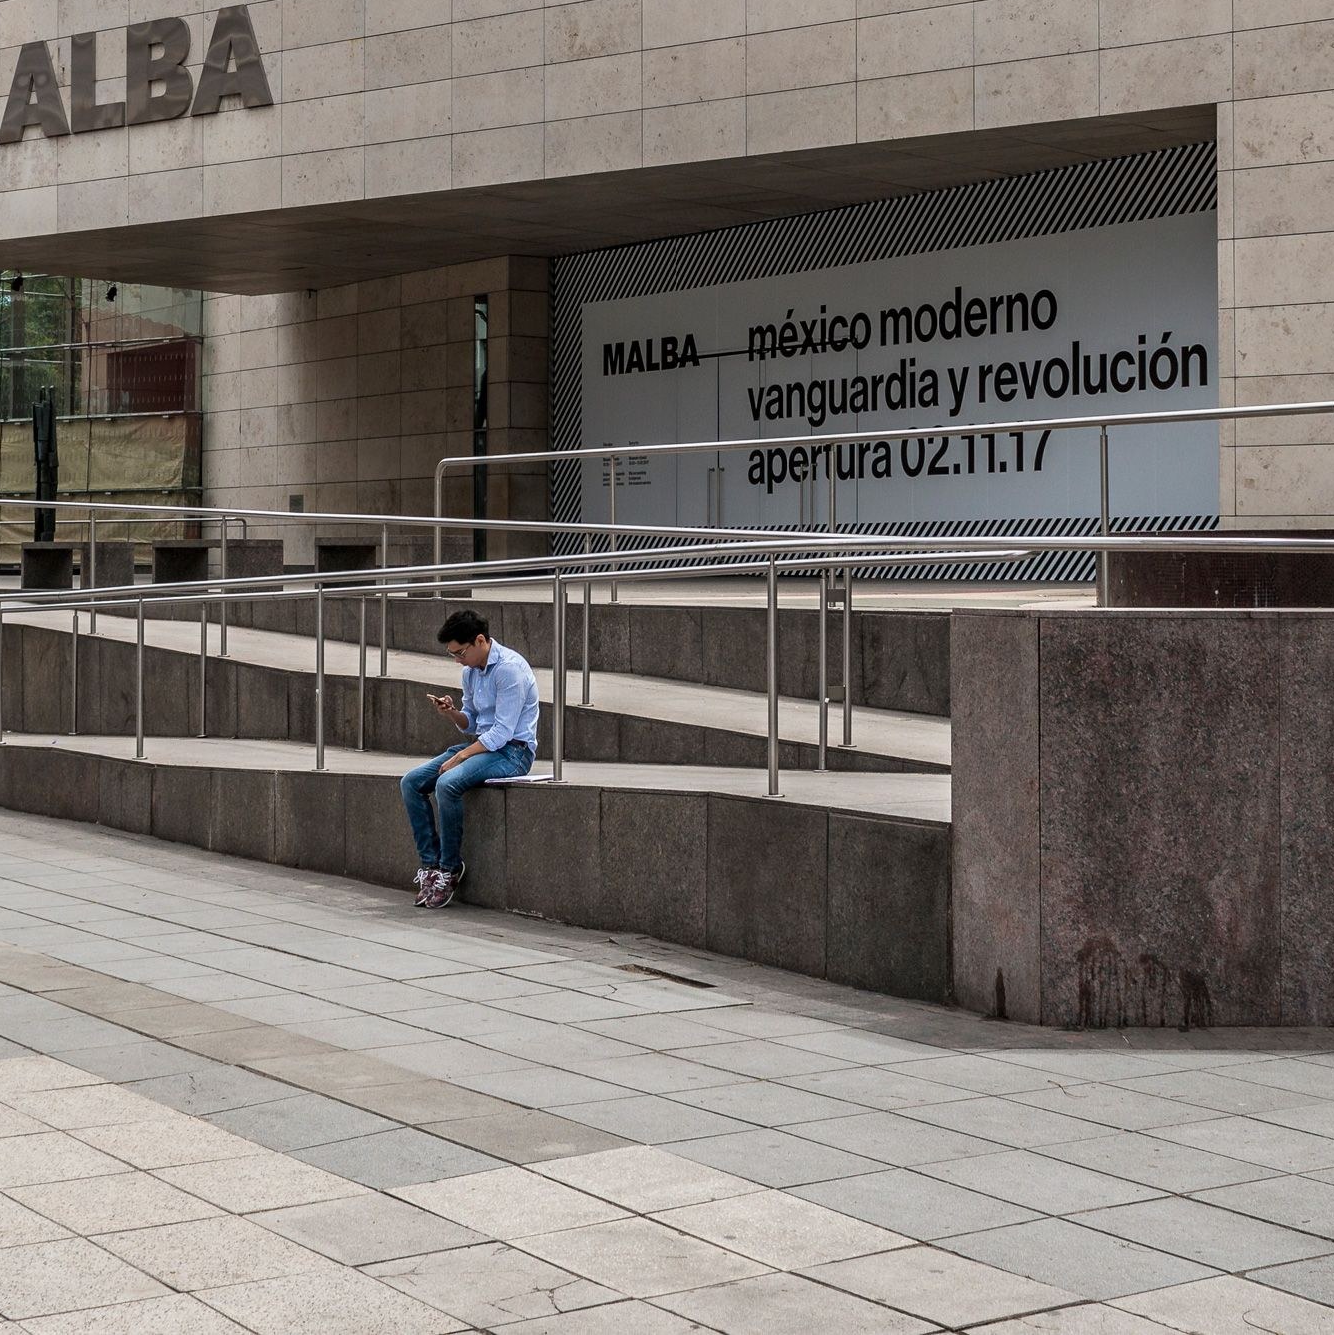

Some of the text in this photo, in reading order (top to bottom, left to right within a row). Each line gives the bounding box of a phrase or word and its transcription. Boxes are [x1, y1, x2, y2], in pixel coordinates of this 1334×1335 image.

[603, 334, 700, 376] MALBA
[748, 286, 1058, 362] méxico moderno
[747, 331, 1208, 428] vanguardia y revolución
[747, 420, 1051, 494] apertura 02.11.17
